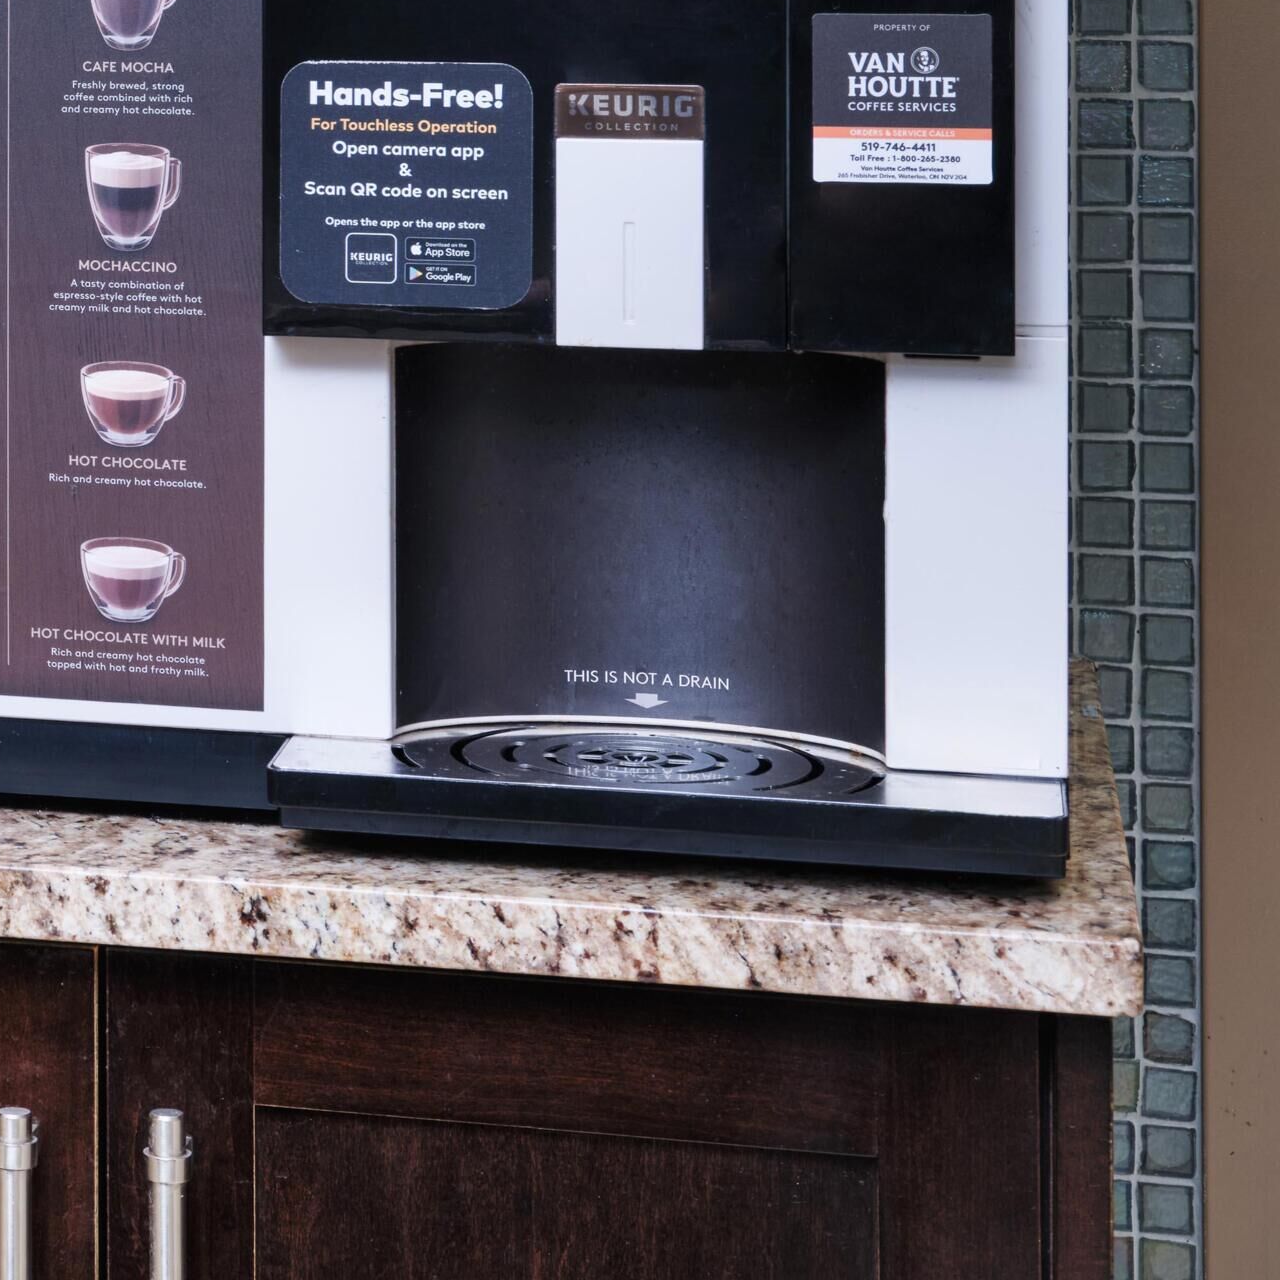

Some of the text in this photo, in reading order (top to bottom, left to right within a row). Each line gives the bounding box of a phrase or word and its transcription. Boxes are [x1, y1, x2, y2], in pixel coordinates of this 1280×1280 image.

[873, 24, 931, 32] PROPERTY OF
[82, 61, 174, 74] CAFE MOCHA
[848, 52, 905, 73] VAN
[72, 80, 185, 93] Freshly brewed, strong
[848, 76, 957, 98] HOUTTE
[309, 81, 504, 109] Hands-Free!
[569, 94, 694, 117] KEURIG
[848, 101, 957, 112] COFFEE SERVICES
[311, 118, 497, 135] For Touchless Operation
[585, 123, 678, 132] COLLECTION
[333, 141, 484, 160] Open camera app
[861, 142, 936, 152] 519-746-4411
[892, 155, 961, 163] 1-800-265-2380
[304, 182, 508, 201] Scan QR code on screen
[78, 259, 177, 273] MOCHACCINO
[69, 455, 187, 470] HOT CHOCOLATE
[48, 473, 207, 489] Rich and creamy hot chocolate.
[31, 627, 226, 649] HOT CHOCOLATE WITH MILK
[564, 669, 730, 690] THIS IS NOT A DRAIN
